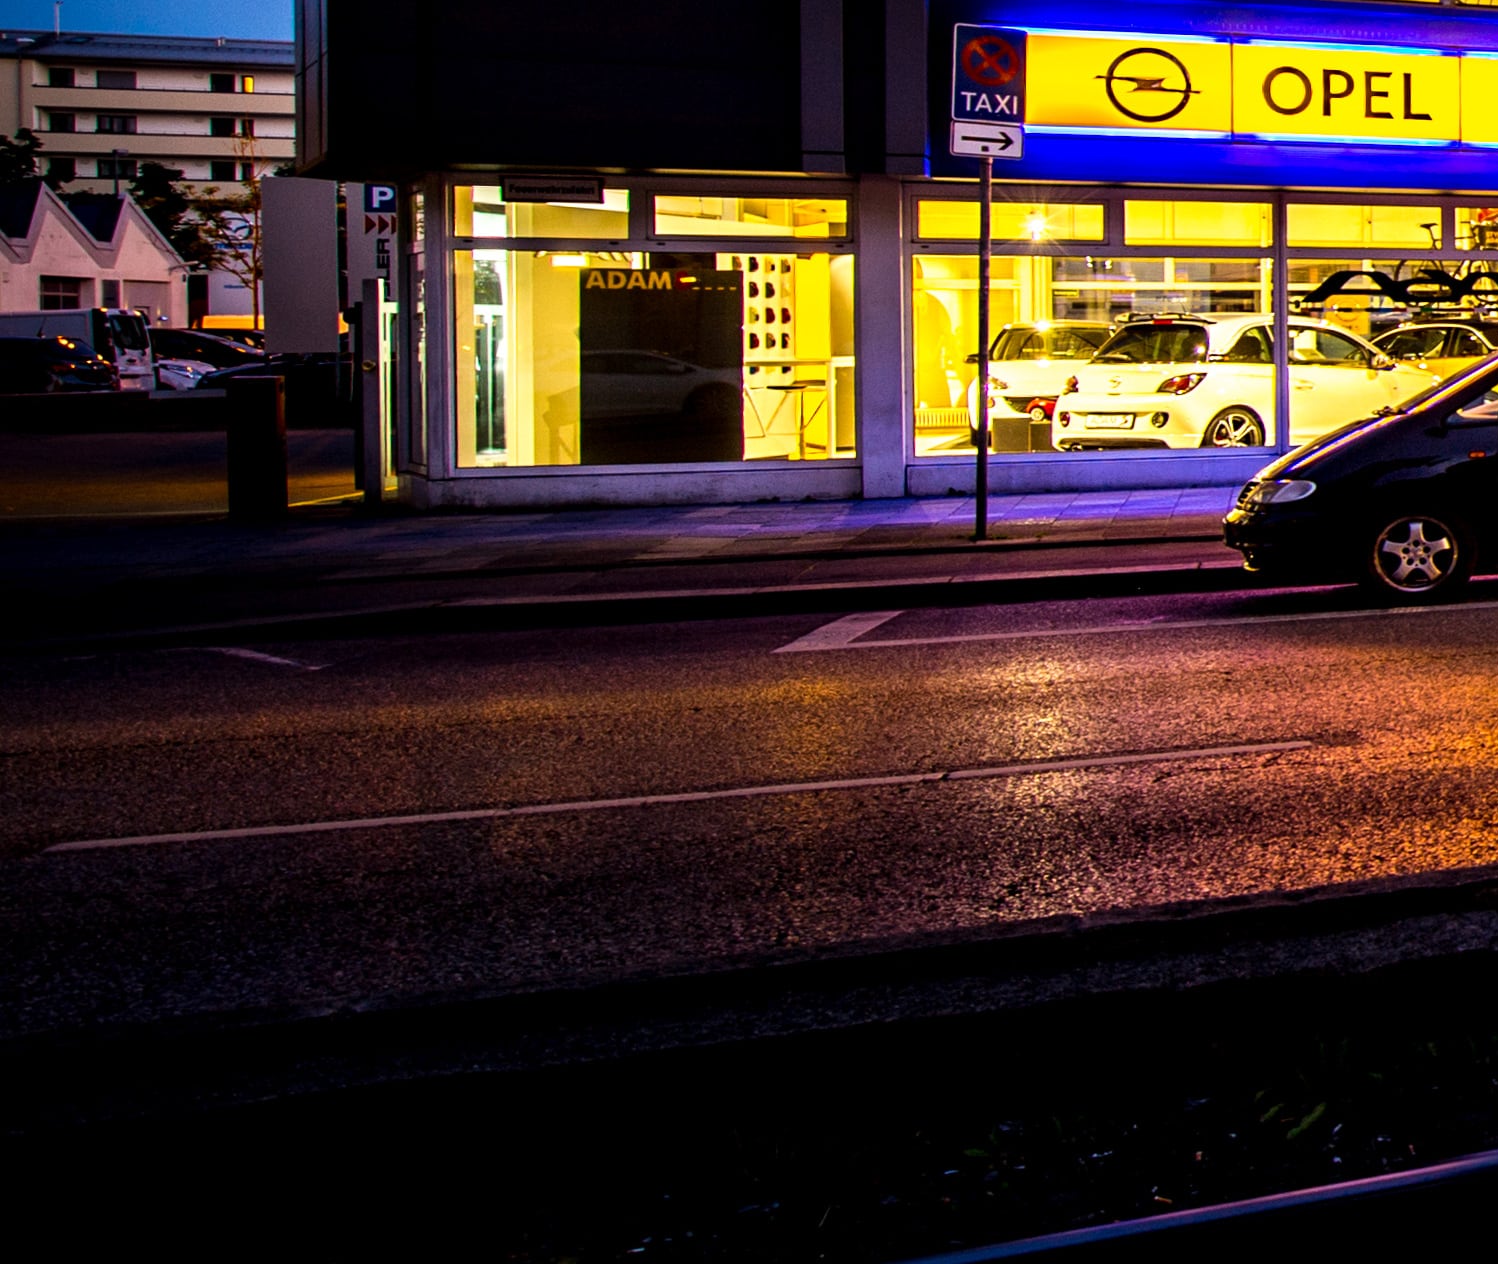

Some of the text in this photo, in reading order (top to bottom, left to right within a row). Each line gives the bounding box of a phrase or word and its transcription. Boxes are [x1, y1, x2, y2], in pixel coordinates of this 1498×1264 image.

[960, 91, 1018, 115] TAXI
[1262, 66, 1432, 121] OPEL
[372, 186, 394, 209] P
[585, 270, 673, 290] ADAM
